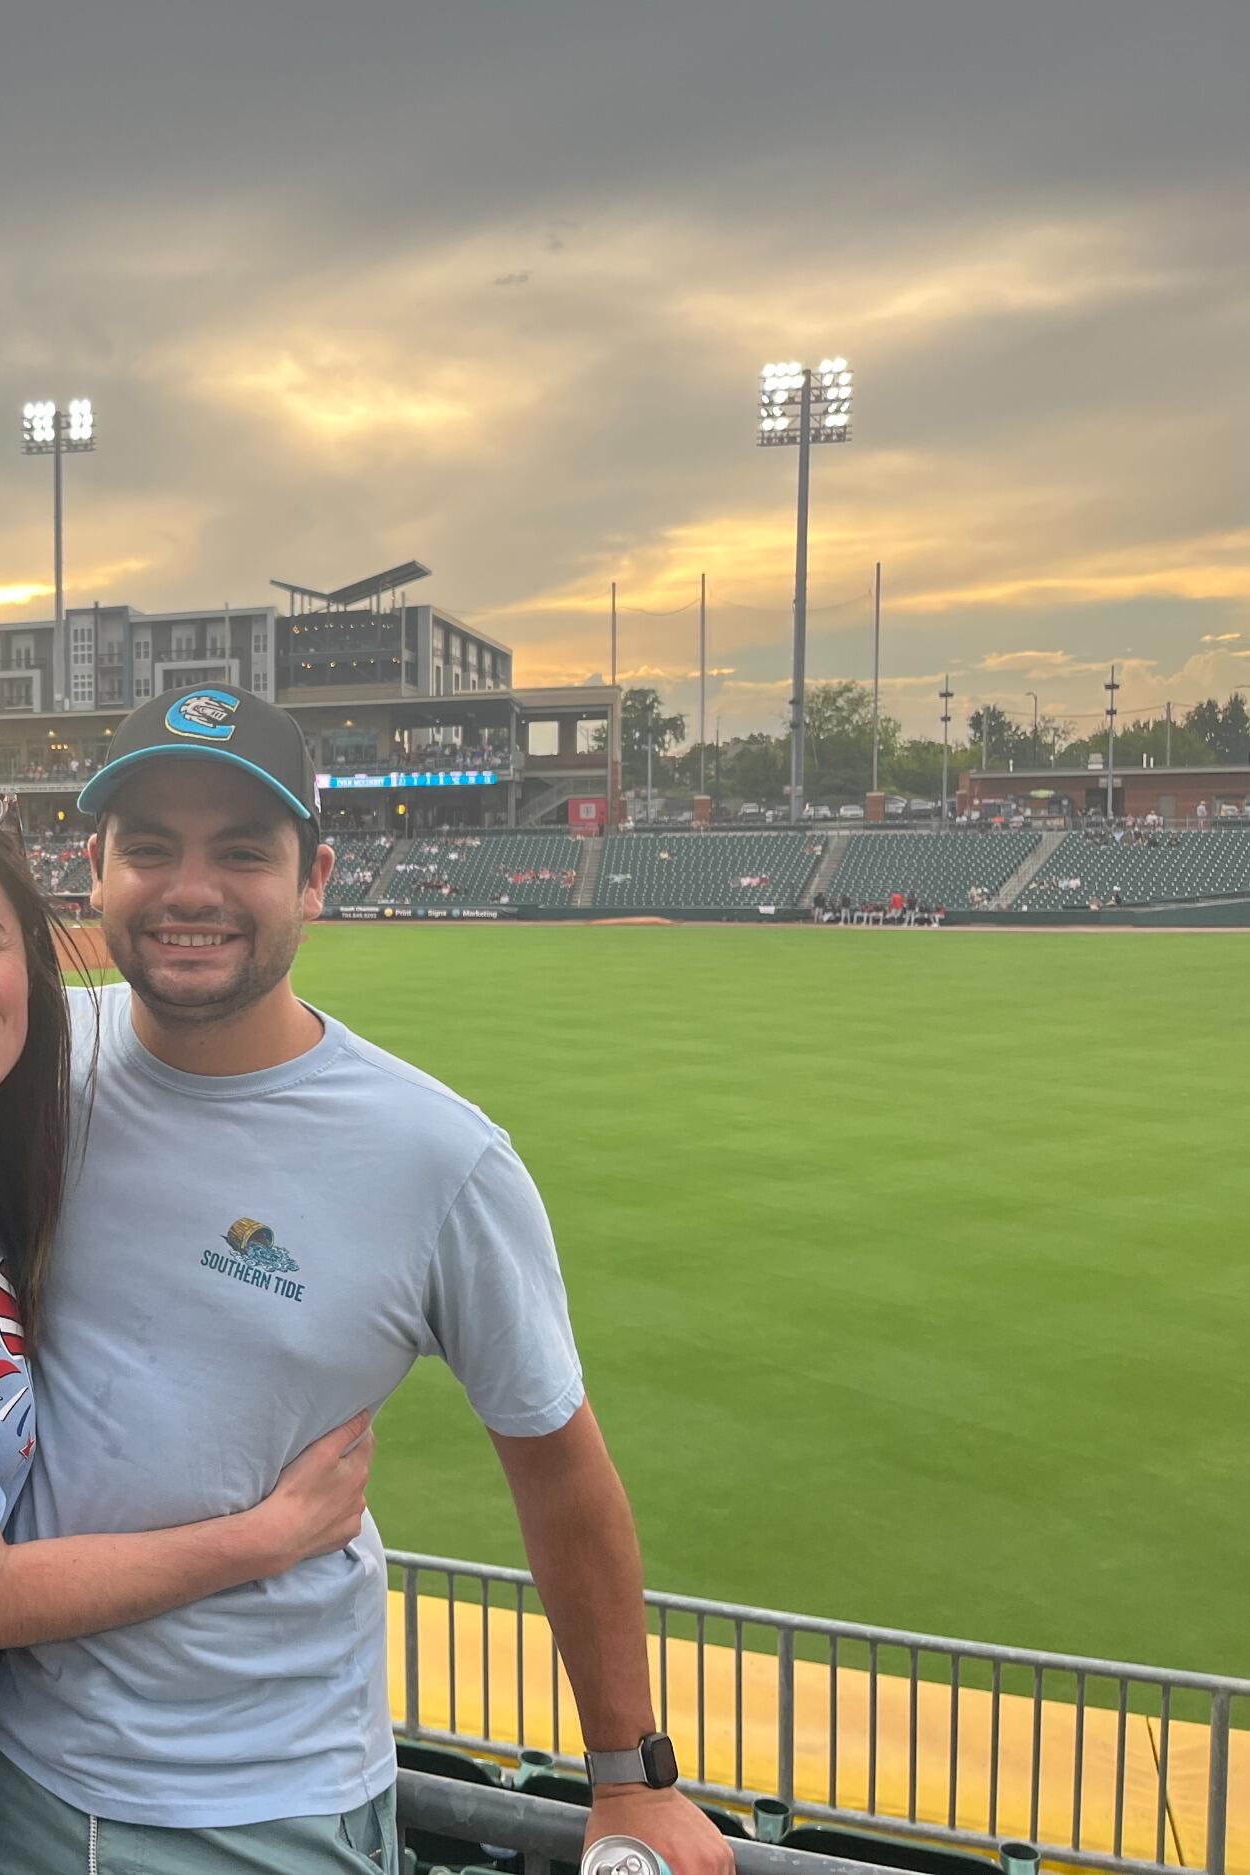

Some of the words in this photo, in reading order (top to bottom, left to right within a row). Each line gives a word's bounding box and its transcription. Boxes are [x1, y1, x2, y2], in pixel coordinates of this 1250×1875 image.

[395, 908, 411, 917] Print
[462, 909, 498, 919] Marketing
[200, 1249, 271, 1290] SOUTHERN
[274, 1276, 305, 1302] TIDE
